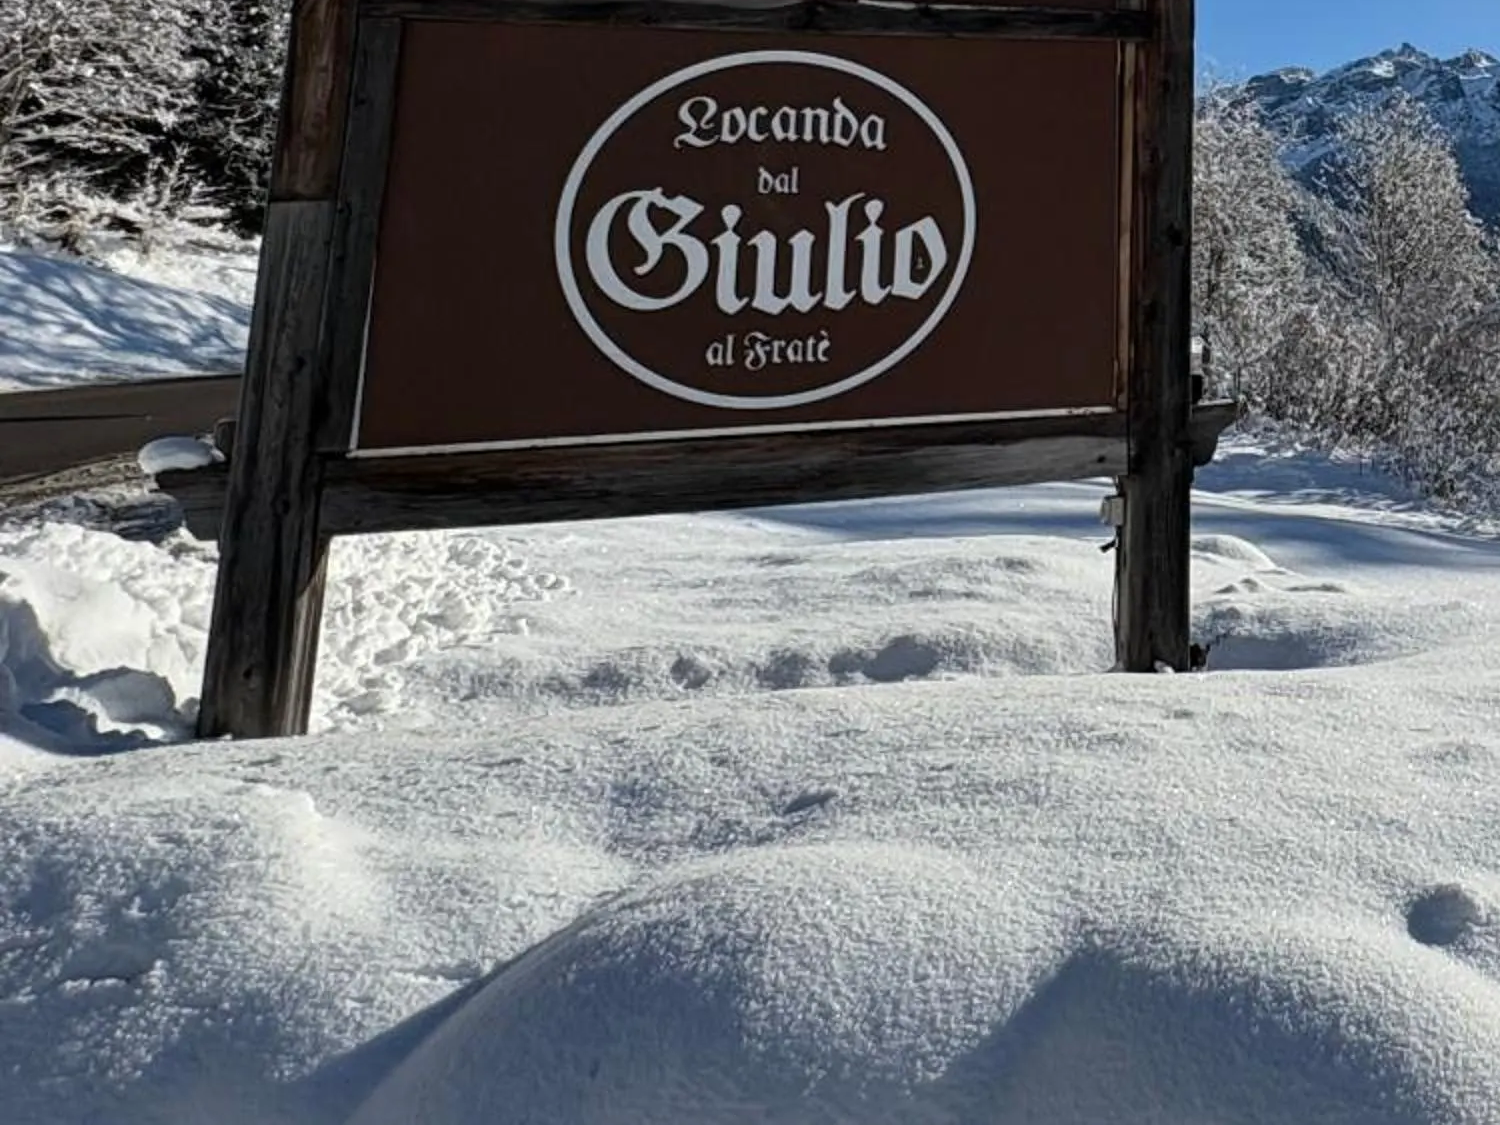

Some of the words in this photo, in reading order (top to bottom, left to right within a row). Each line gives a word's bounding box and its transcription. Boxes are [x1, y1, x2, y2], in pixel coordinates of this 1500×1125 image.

[673, 96, 887, 151] Locanda
[757, 166, 799, 194] dal
[585, 186, 948, 316] Giulio
[705, 333, 735, 367] al
